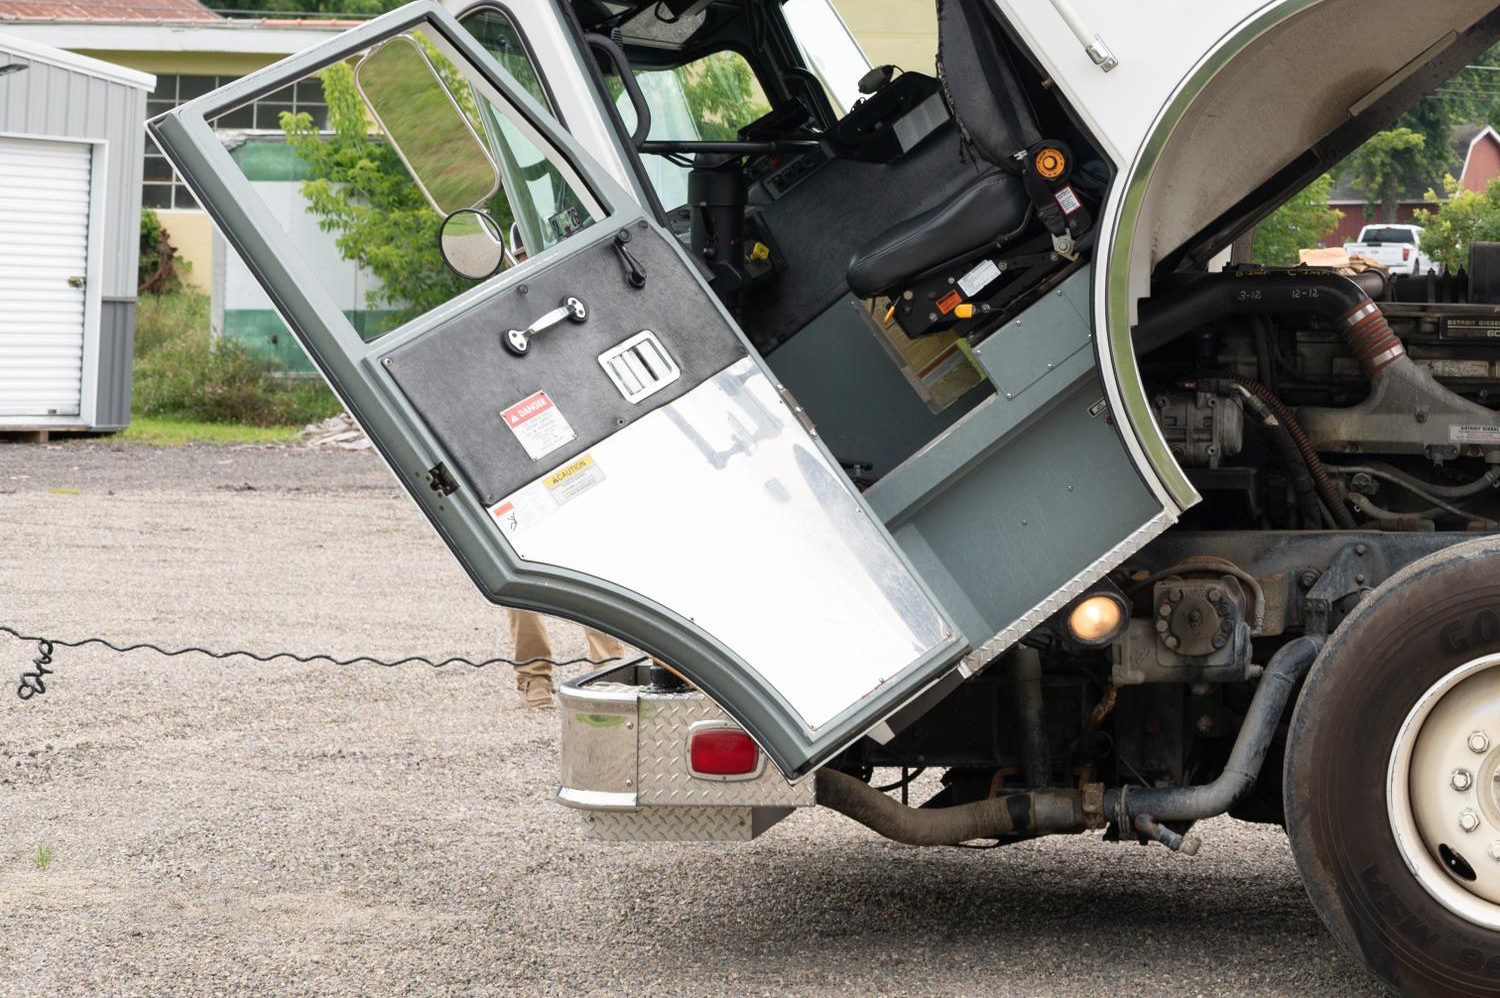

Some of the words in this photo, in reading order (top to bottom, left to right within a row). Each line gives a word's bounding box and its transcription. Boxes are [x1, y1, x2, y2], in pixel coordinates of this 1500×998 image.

[1291, 288, 1319, 298] 12-12
[517, 397, 548, 418] DANGER
[557, 459, 587, 481] CAUTION
